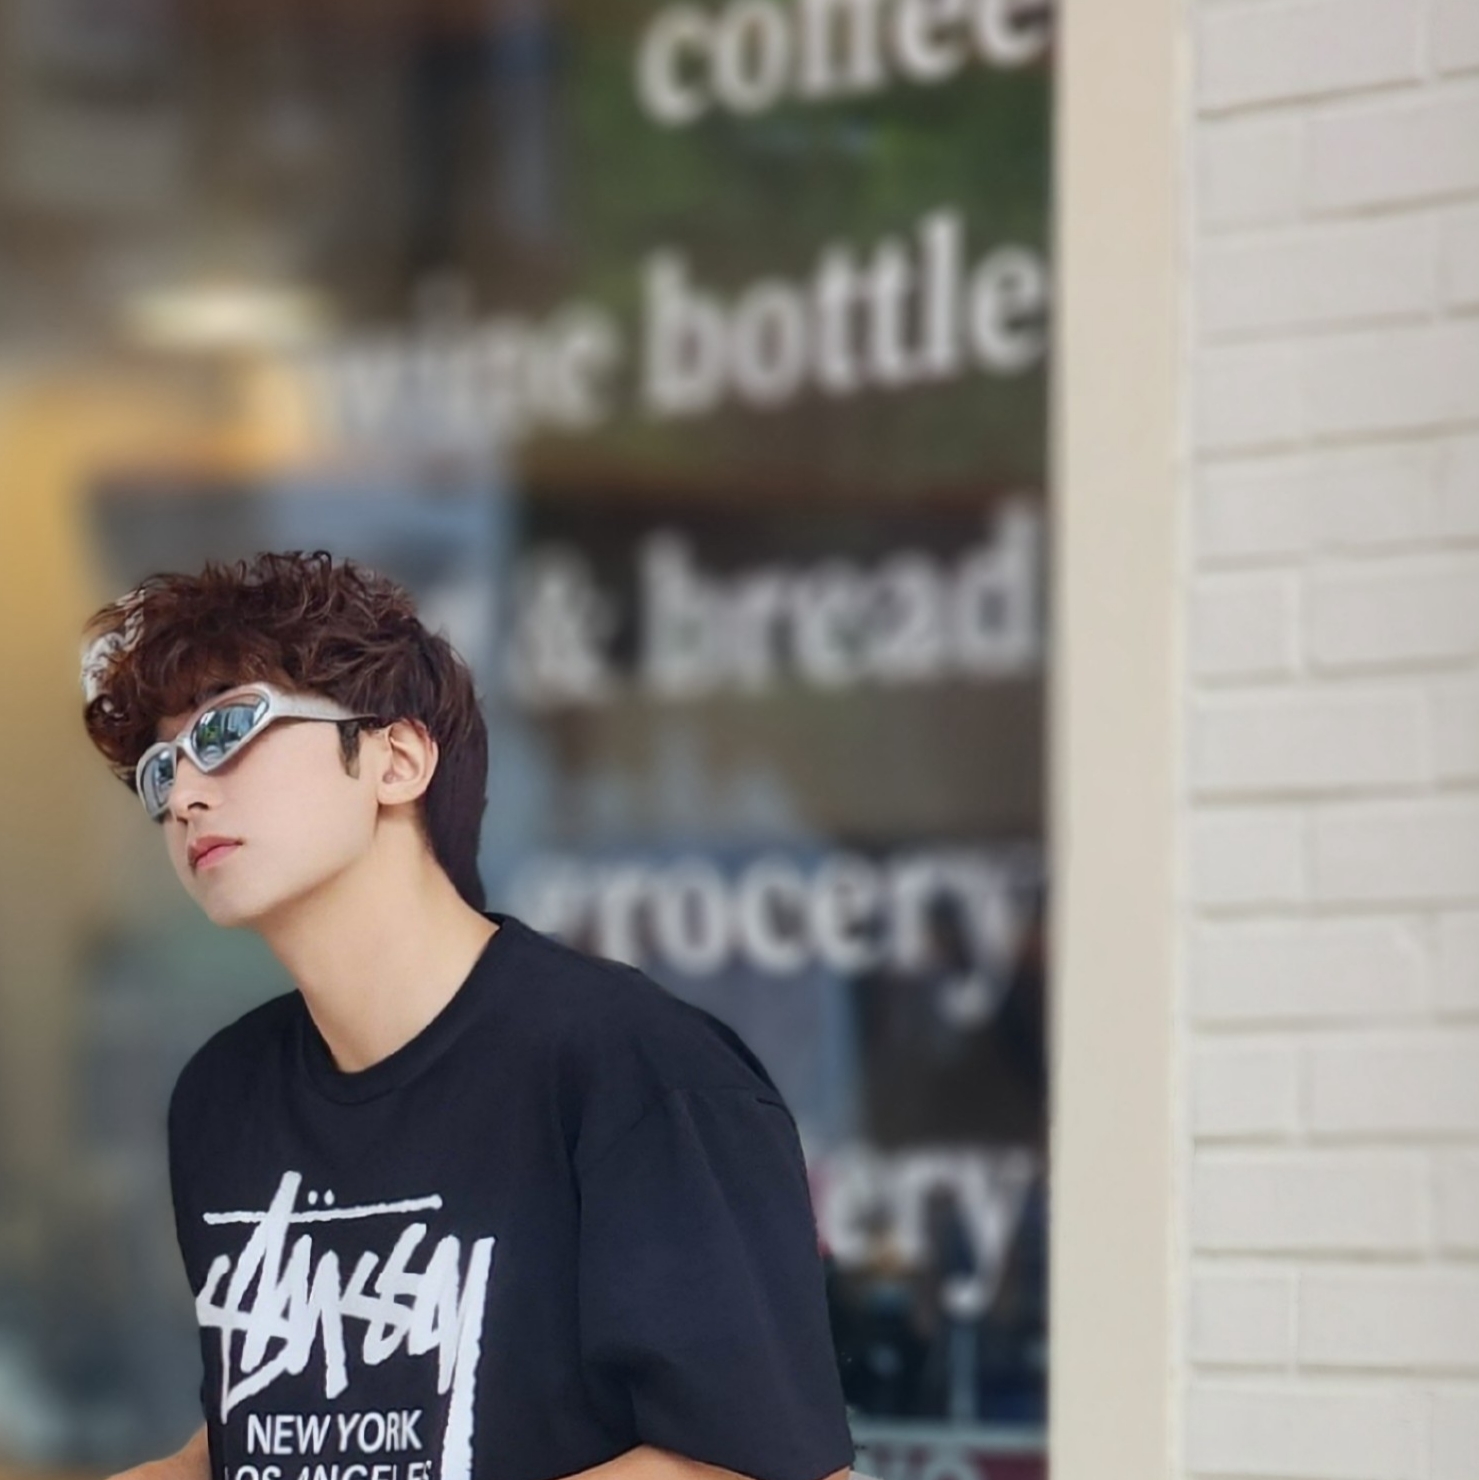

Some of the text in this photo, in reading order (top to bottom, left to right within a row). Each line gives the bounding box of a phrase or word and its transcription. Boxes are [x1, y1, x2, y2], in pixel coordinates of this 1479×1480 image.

[644, 207, 1048, 415] bottle
[637, 496, 1040, 694] bread
[247, 1409, 422, 1455] NEW YORK
